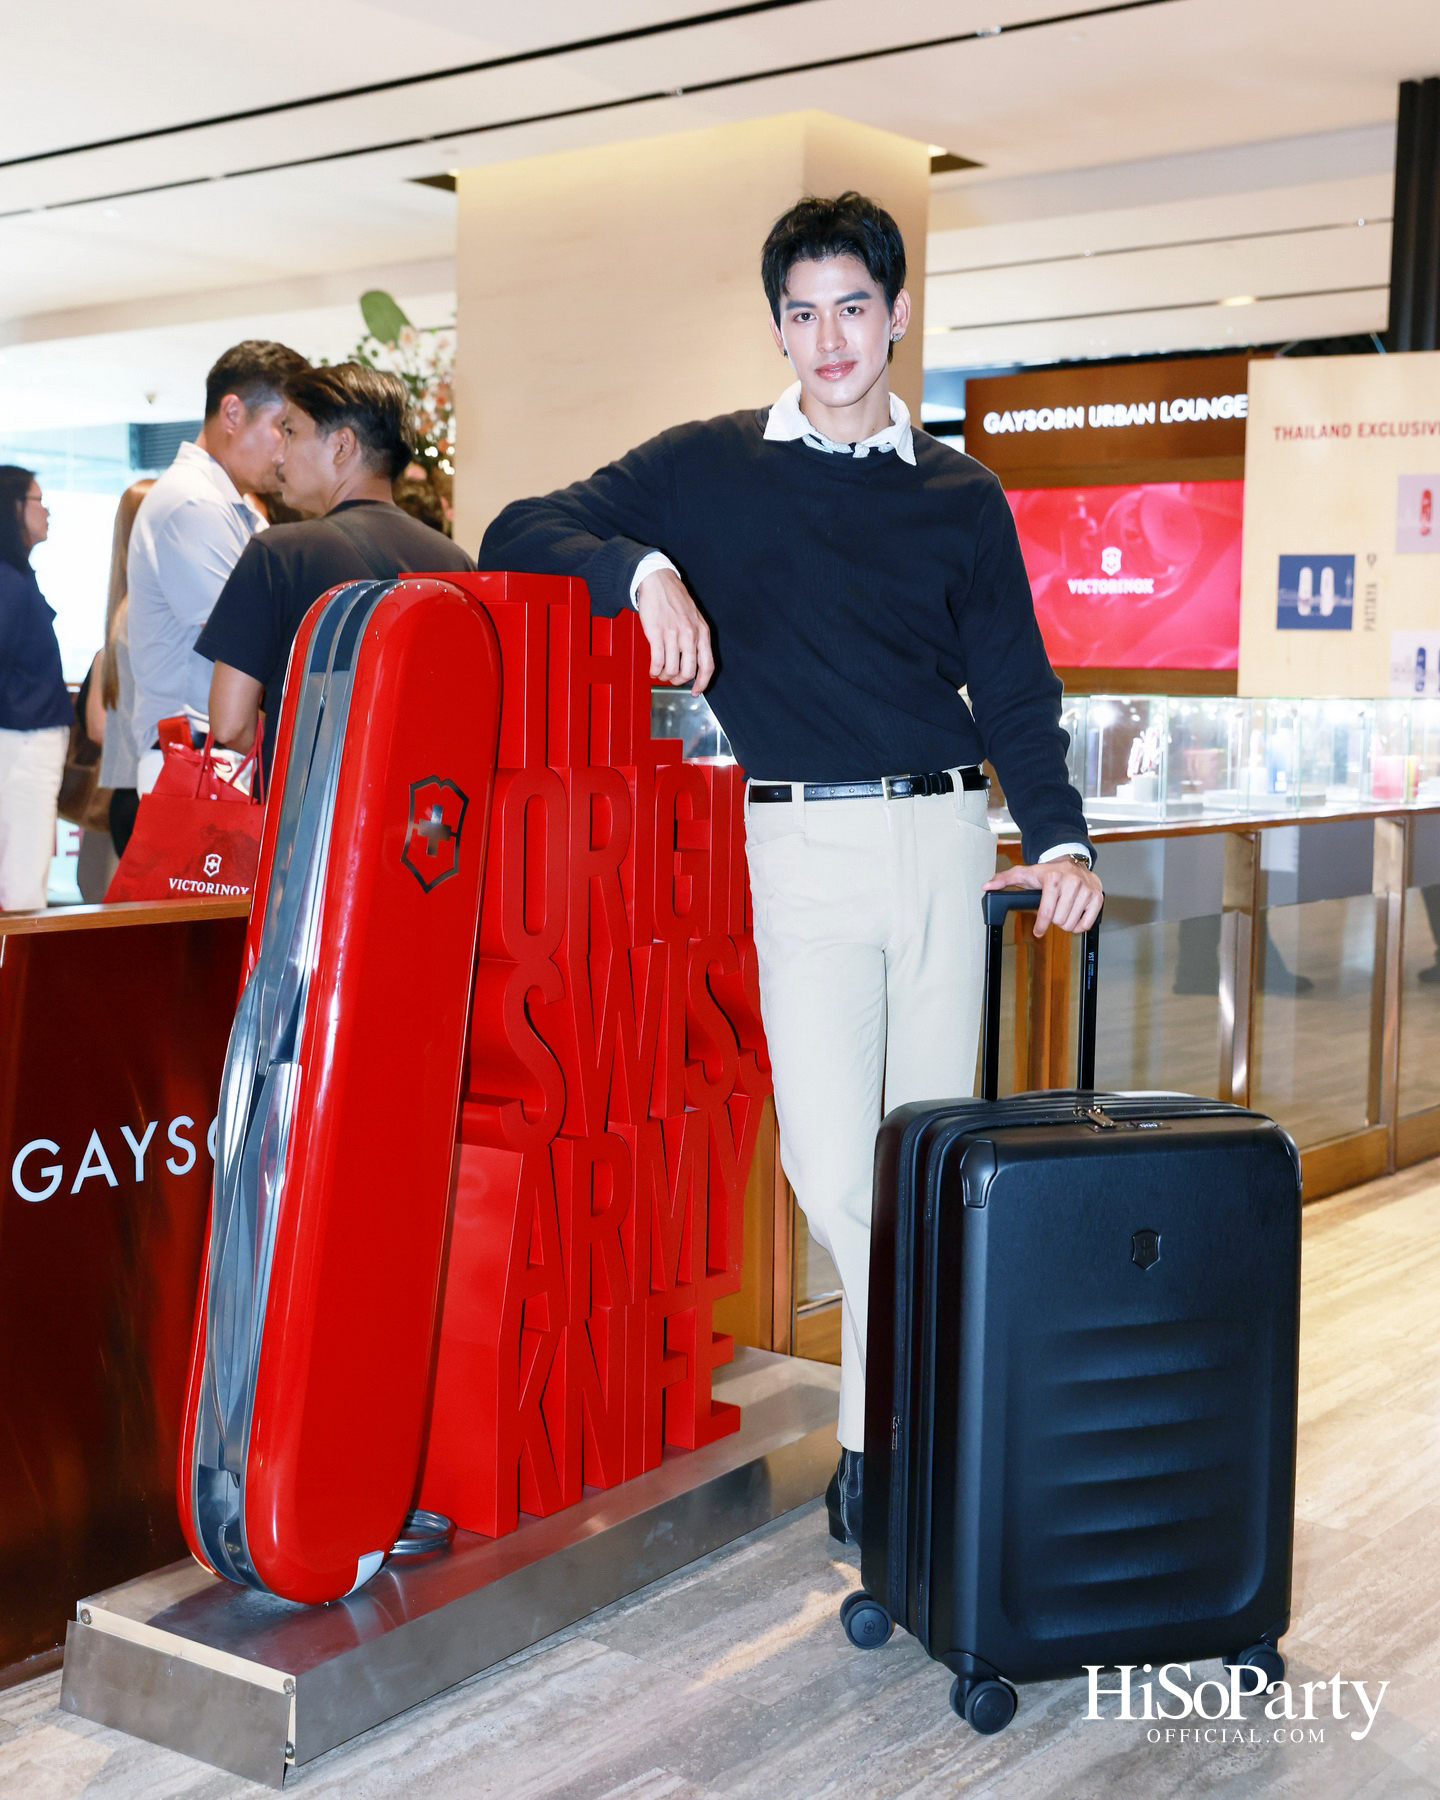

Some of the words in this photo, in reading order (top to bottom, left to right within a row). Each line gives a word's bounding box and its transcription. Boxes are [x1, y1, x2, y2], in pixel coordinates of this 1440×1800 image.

[983, 406, 1085, 434] GAYSORN
[1088, 402, 1156, 428] URBAN
[1159, 394, 1248, 423] LOUNGE
[1274, 423, 1352, 441] THAILAND
[1357, 420, 1440, 438] EXCLUSIV
[1067, 578, 1154, 595] VICTORINOX
[12, 1114, 218, 1202] GAYS
[502, 1092, 772, 1330] ARMY
[497, 1286, 741, 1538] KNIFE
